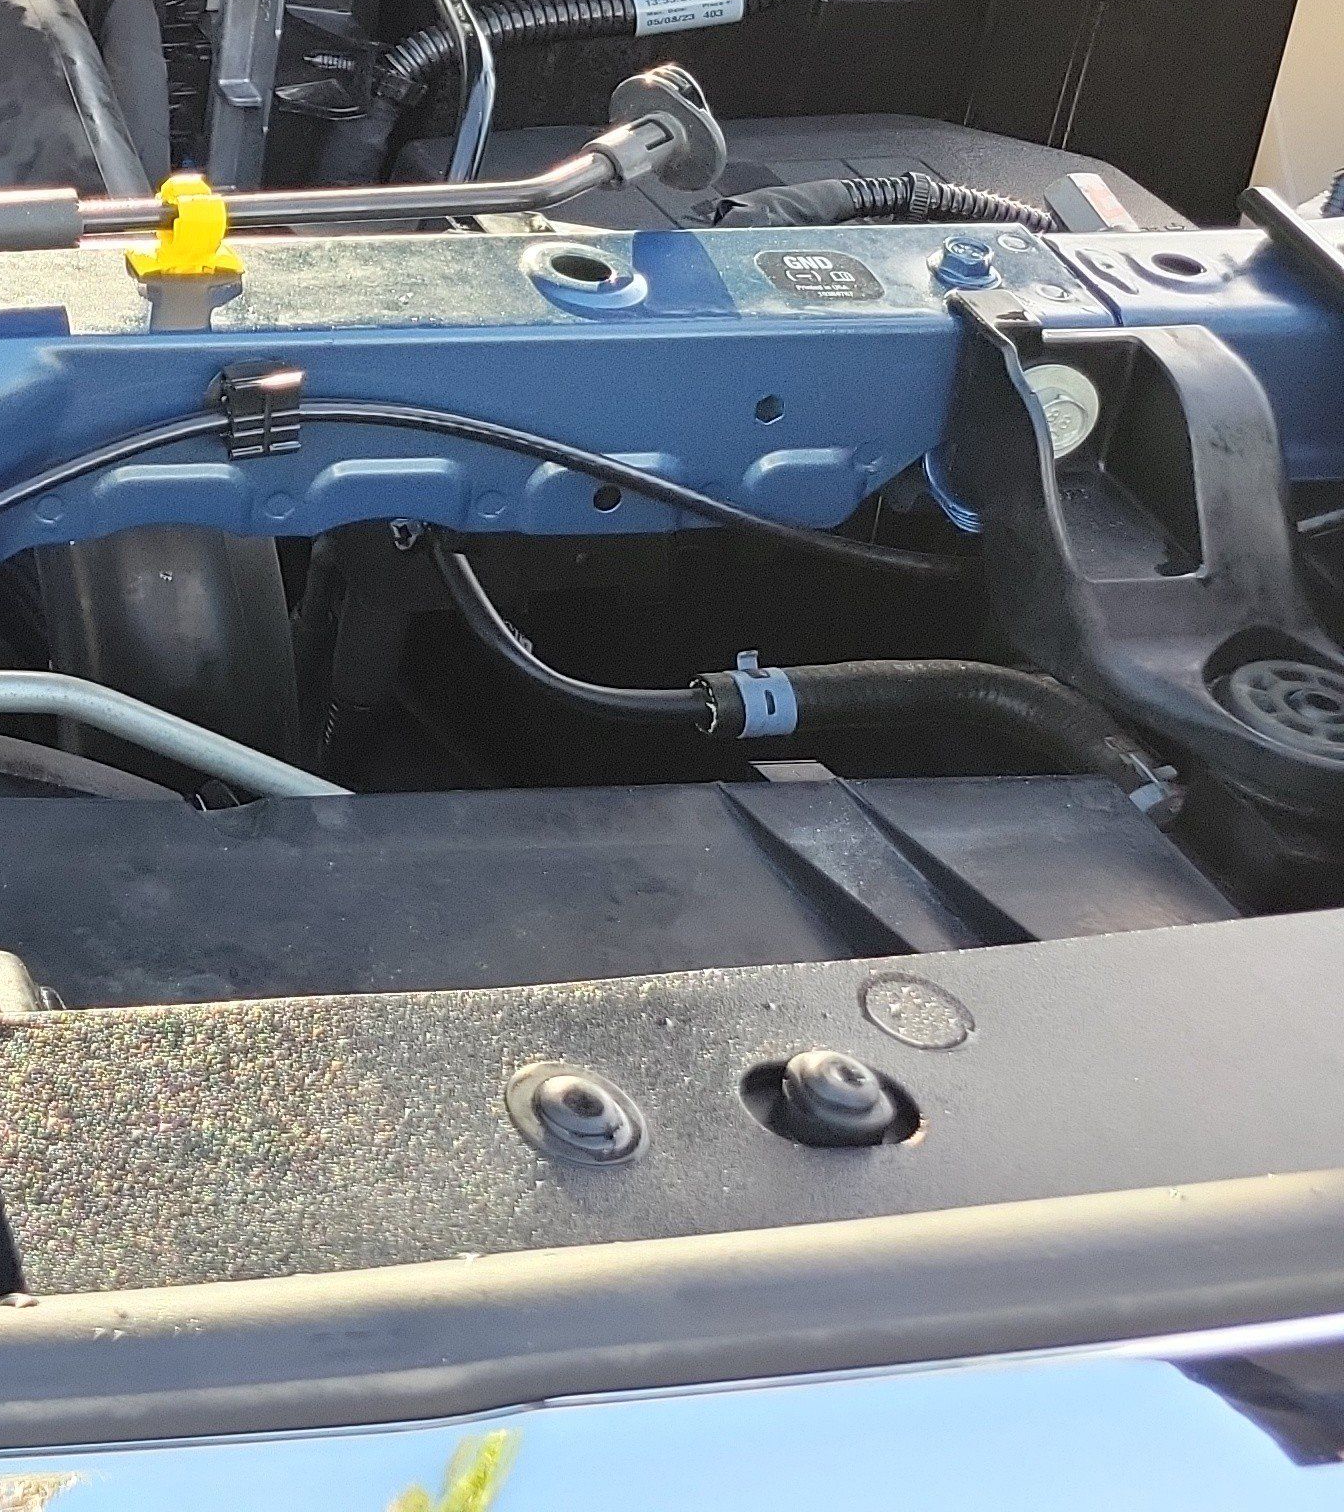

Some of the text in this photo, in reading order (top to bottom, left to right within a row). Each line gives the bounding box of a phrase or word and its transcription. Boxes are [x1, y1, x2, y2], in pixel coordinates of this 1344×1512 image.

[646, 9, 724, 26] 05/08/23 403
[783, 255, 833, 270] GND
